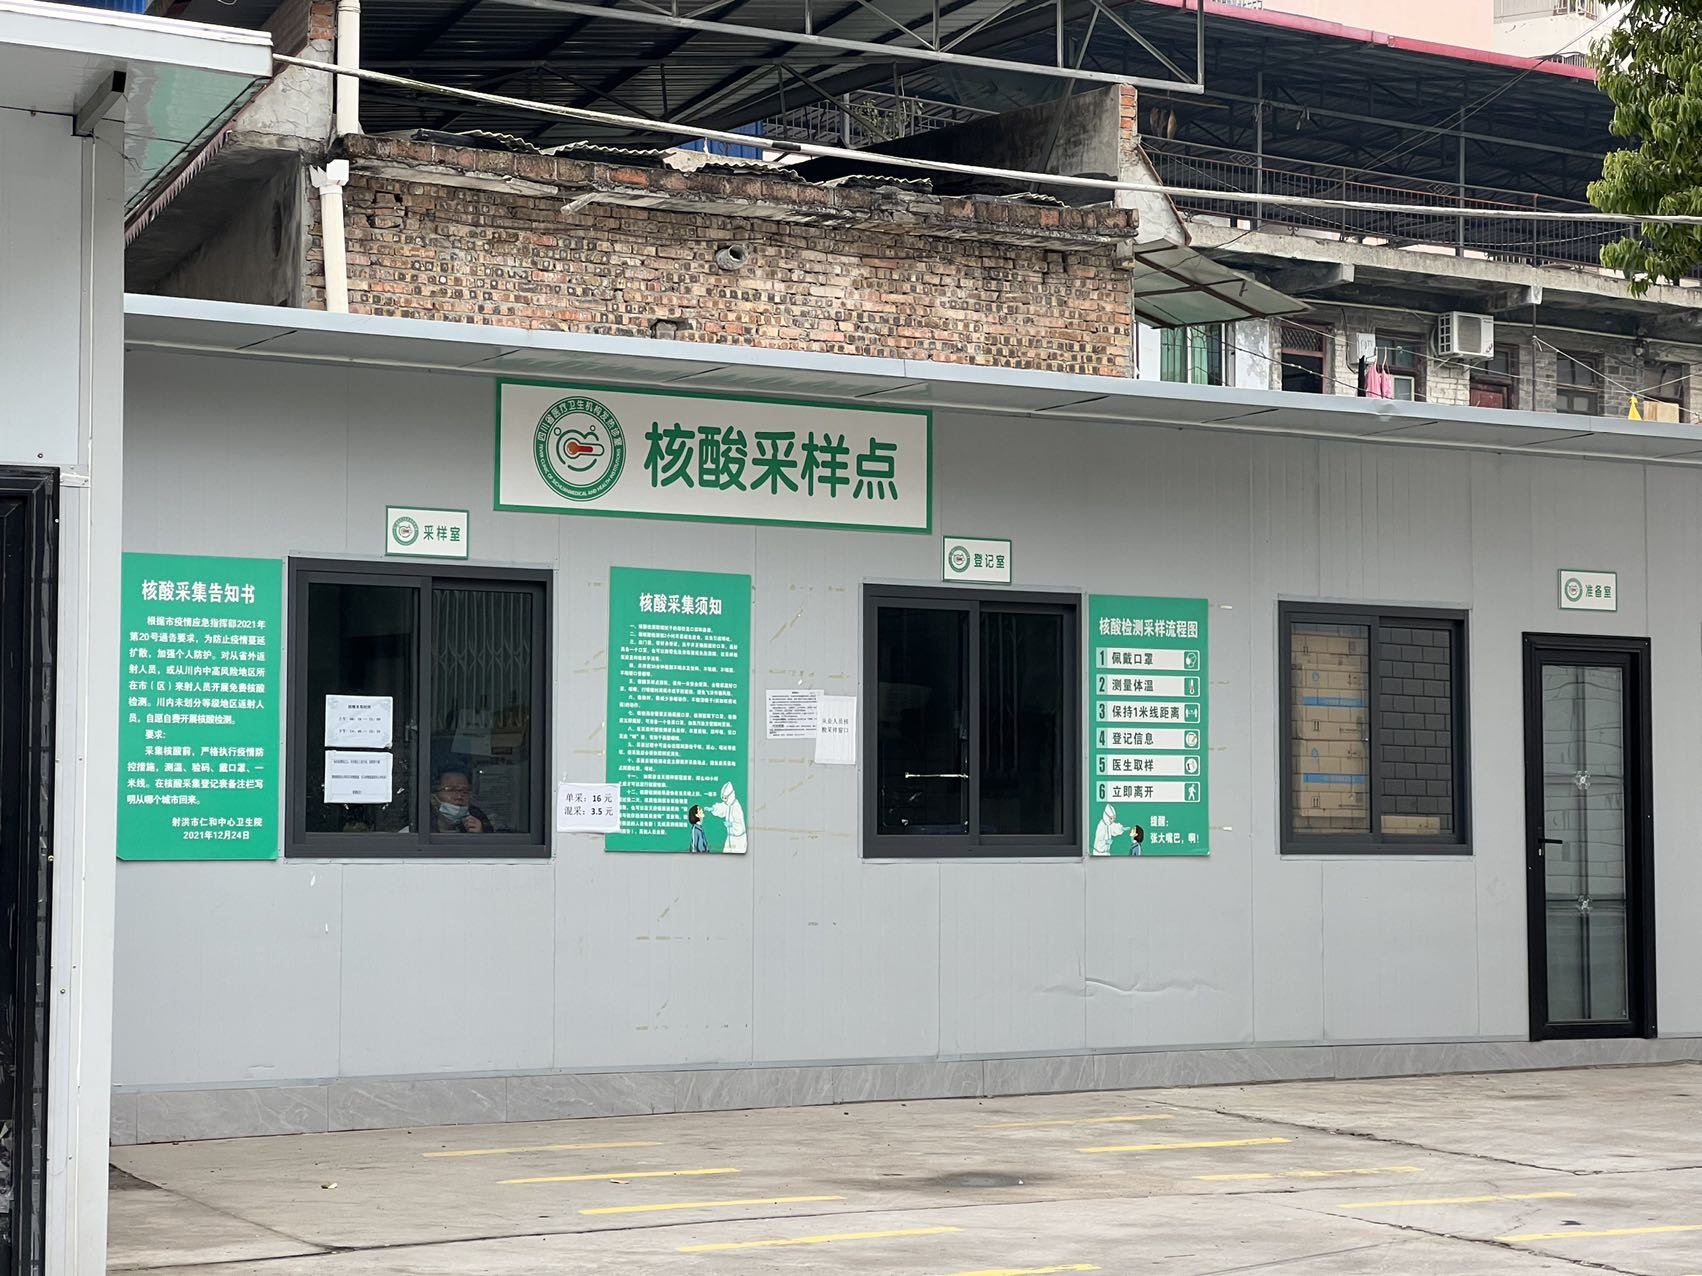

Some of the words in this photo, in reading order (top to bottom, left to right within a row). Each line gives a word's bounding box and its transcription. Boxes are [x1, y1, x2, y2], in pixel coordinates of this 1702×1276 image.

[643, 420, 899, 501] 核酸采样点
[423, 524, 461, 542] 采样室
[973, 553, 1005, 569] 登记室
[141, 579, 256, 604] 核酸采集告知书
[1585, 584, 1612, 599] 准备室
[639, 593, 722, 615] 核酸采集须知
[1099, 617, 1198, 639] 核酸检测采样流程图
[1099, 651, 1105, 665] 1
[1112, 652, 1153, 665] 佩戴口罩
[1099, 678, 1105, 692] 2
[1112, 679, 1154, 692] 测量体温
[1099, 704, 1105, 719] 3
[1112, 705, 1180, 719] 保持1米线距离
[1099, 731, 1105, 745] 4
[1112, 732, 1154, 745] 登记信息
[1099, 758, 1105, 772] 5
[1112, 759, 1154, 772] 医生取样
[1099, 784, 1105, 798] 6
[1112, 785, 1154, 798] 立即离开
[171, 817, 263, 828] 射洪市仁和中心卫生院
[183, 830, 250, 841] 2021年12月24日
